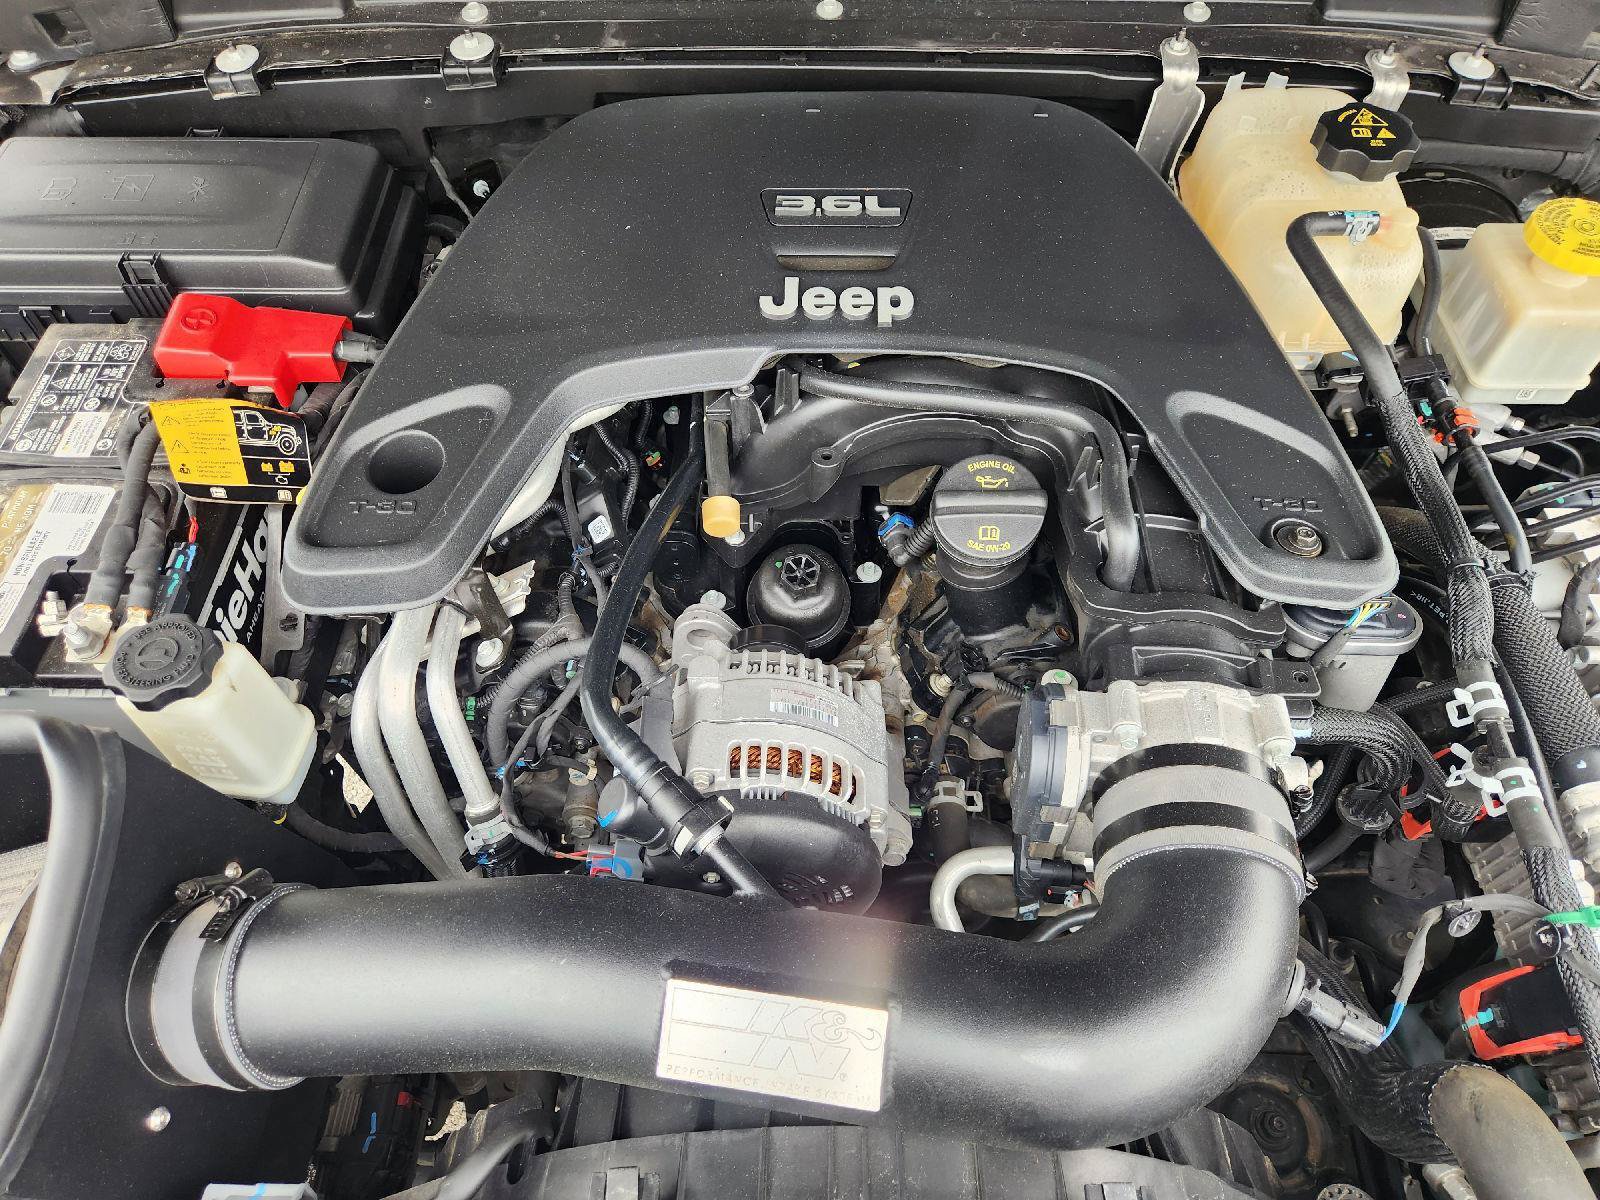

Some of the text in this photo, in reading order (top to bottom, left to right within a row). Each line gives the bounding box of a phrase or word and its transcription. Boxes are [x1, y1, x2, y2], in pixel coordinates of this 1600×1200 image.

[774, 195, 901, 217] 3.6L
[758, 276, 915, 327] Jeep
[967, 460, 1001, 473] ENGINE
[967, 539, 1011, 552] SAE 0W-20
[154, 621, 197, 641] APPROVED
[126, 674, 173, 687] STEERING
